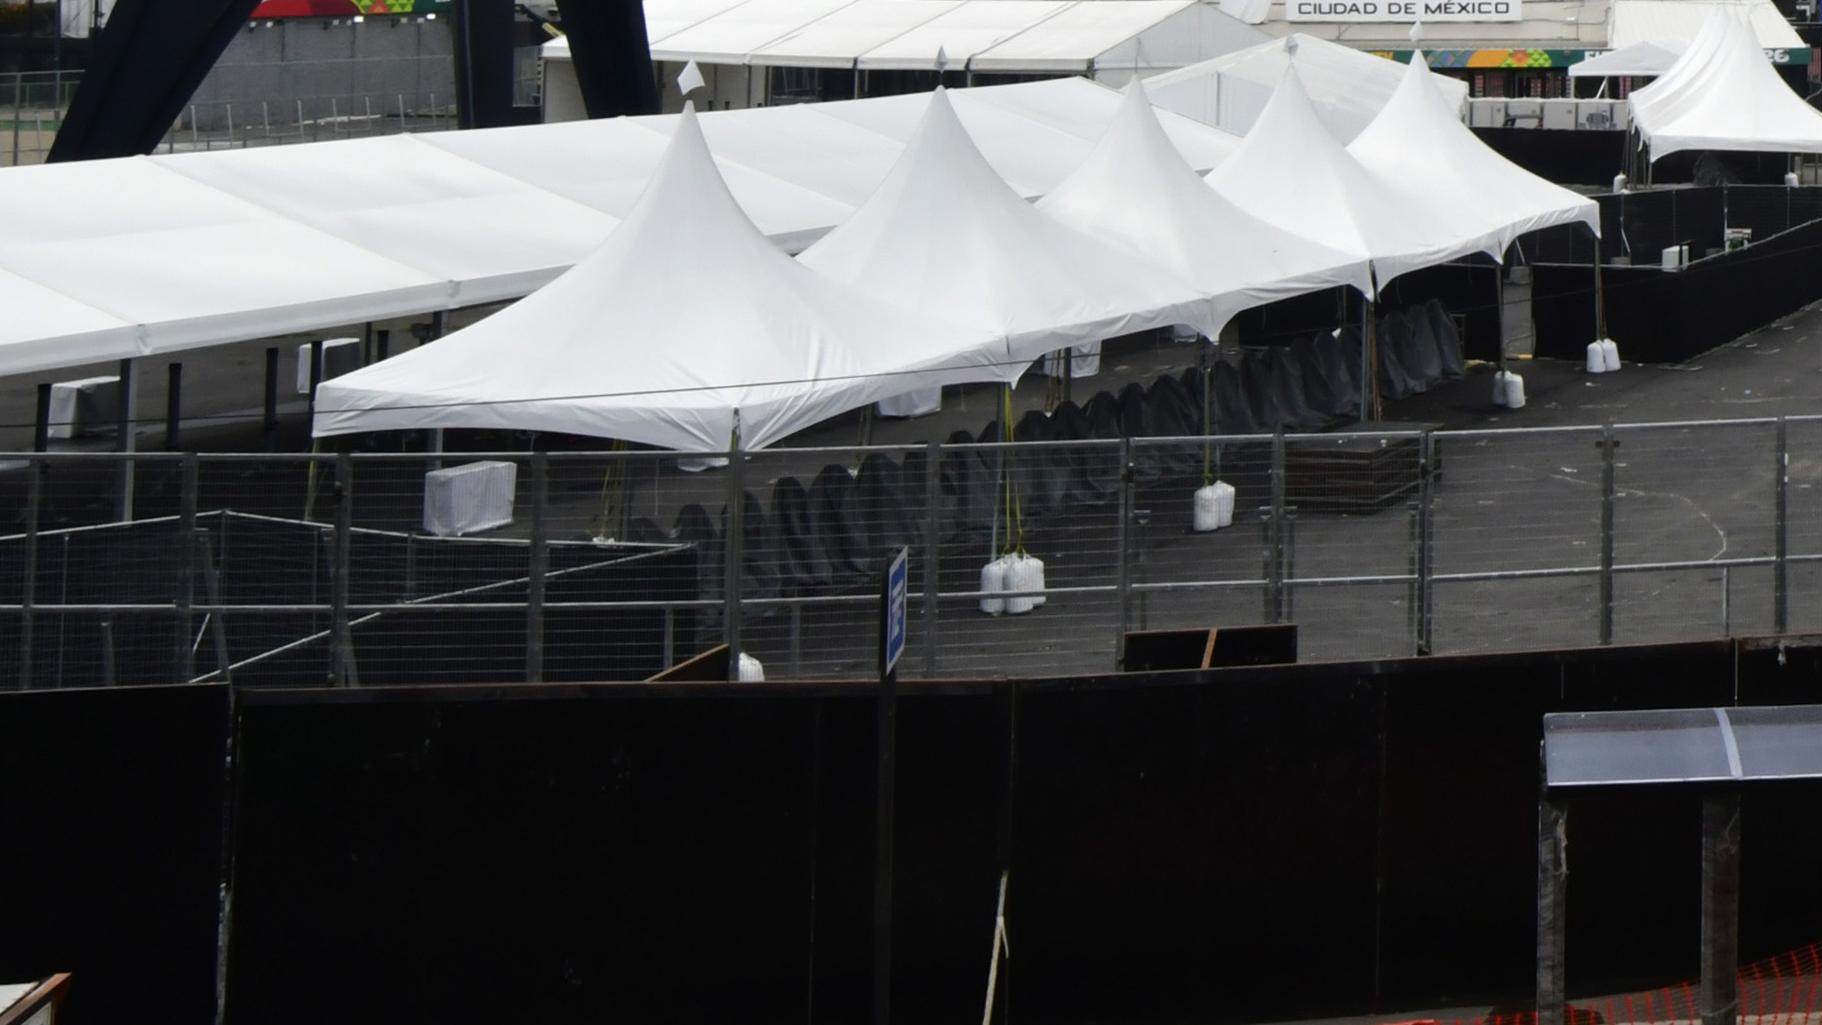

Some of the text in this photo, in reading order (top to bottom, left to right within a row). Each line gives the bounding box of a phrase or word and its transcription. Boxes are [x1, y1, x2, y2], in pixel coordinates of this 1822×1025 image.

[1298, 0, 1510, 15] CIUDAD DE MÉXICO
